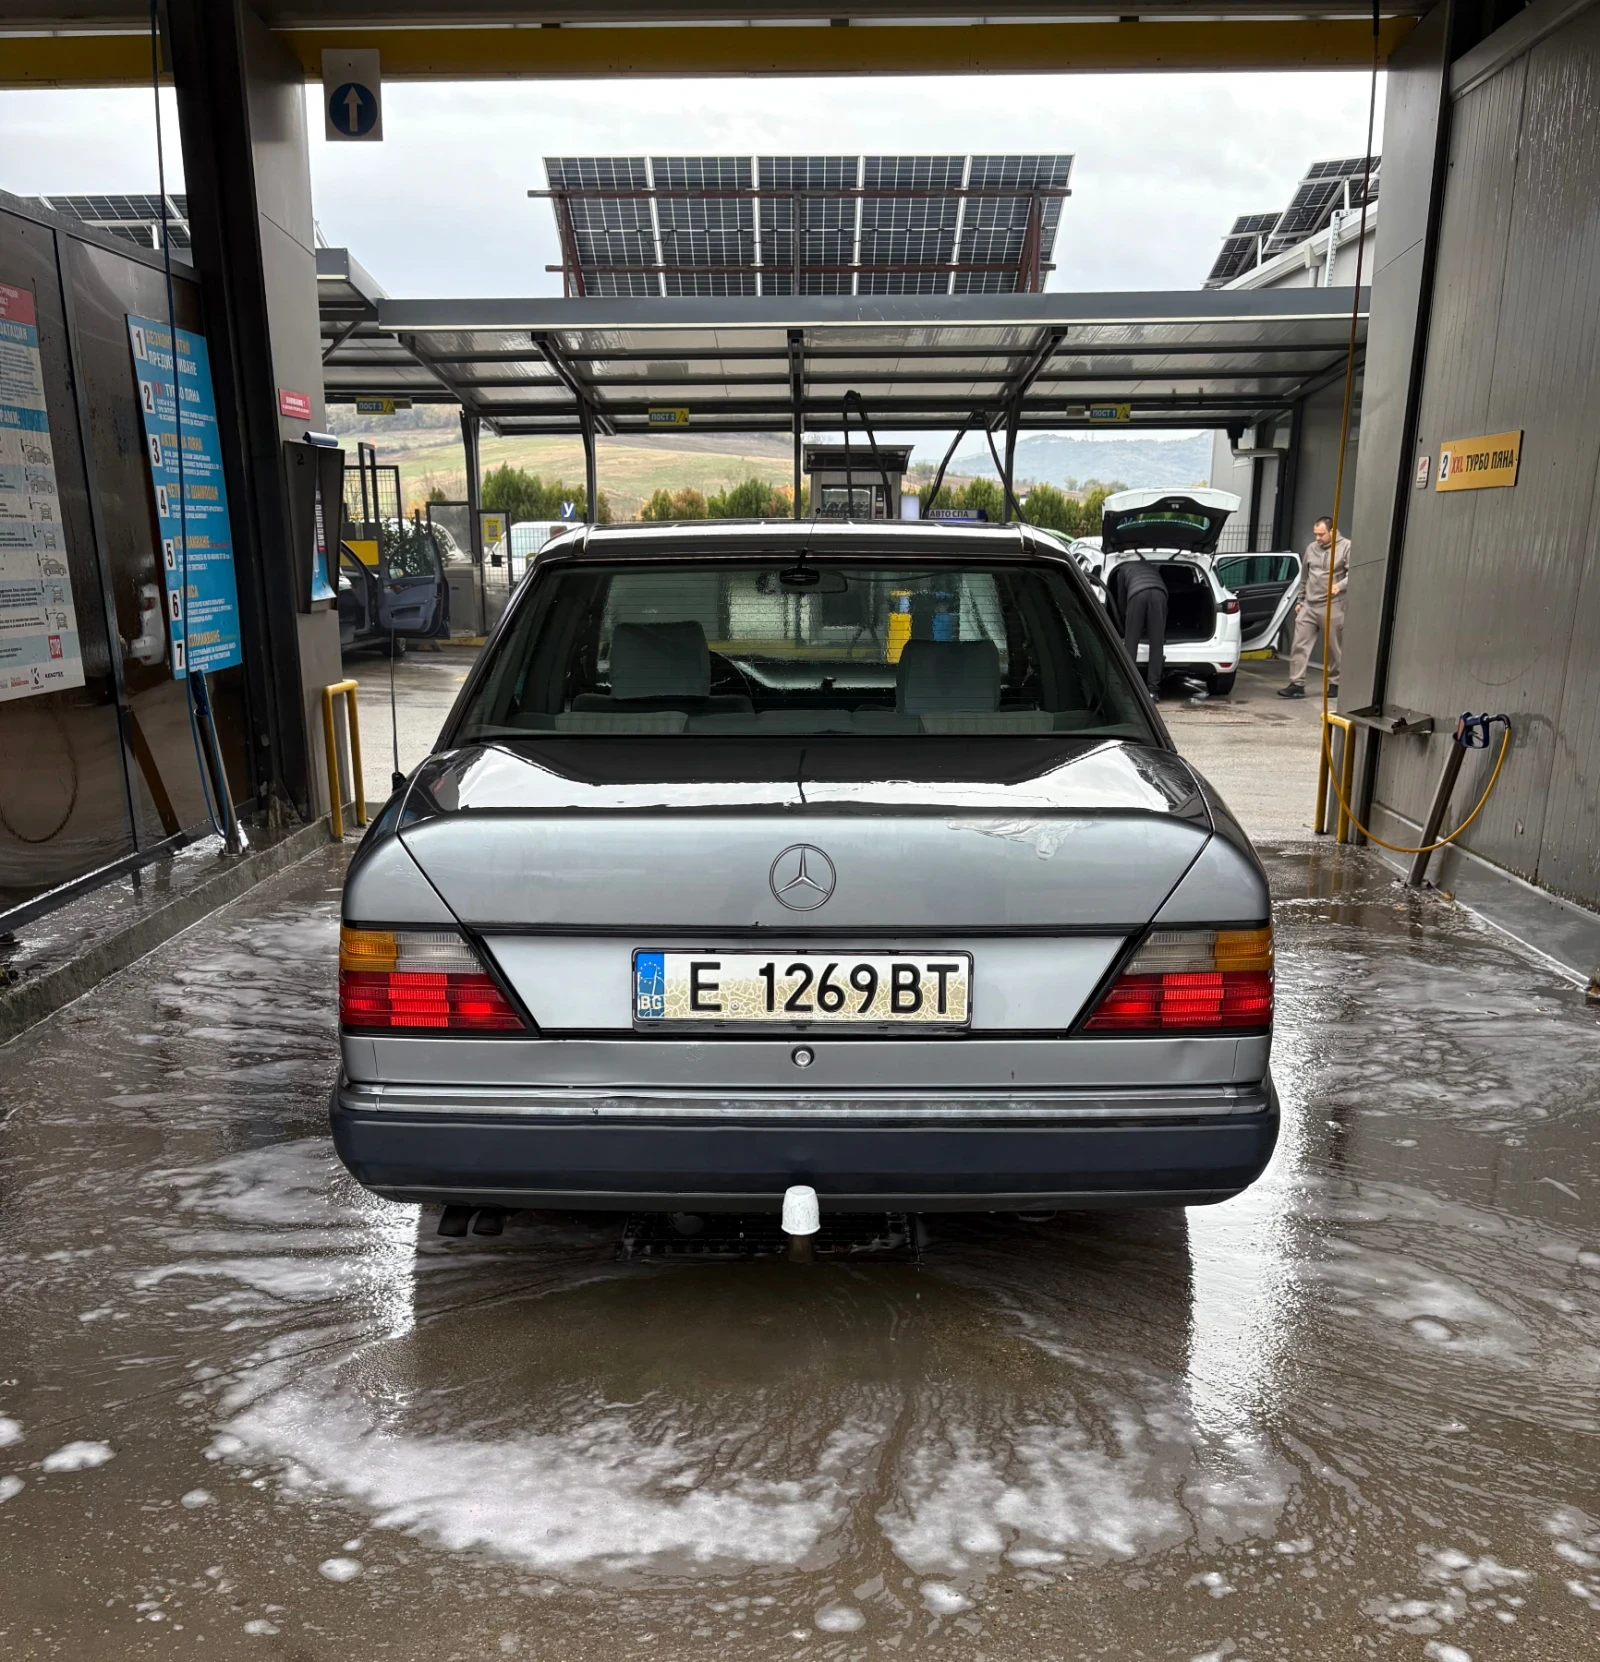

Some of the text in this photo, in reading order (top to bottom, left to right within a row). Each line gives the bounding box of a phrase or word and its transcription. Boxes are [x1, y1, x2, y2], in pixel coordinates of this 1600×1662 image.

[135, 329, 144, 357] 1
[143, 384, 153, 410] 2
[358, 402, 377, 410] ПОСТ
[651, 413, 669, 421] ПОСТ
[152, 438, 160, 464] 3
[296, 452, 304, 466] 2
[1441, 455, 1449, 479] 2
[1451, 456, 1463, 474] XXL
[1465, 452, 1490, 472] ТУРБО
[1491, 449, 1514, 470] ПЯНА
[160, 489, 167, 514] 4
[930, 510, 969, 518] АВТО СПА
[166, 543, 173, 568] 5
[172, 593, 179, 618] 6
[176, 643, 183, 667] 7
[640, 995, 663, 1010] BG
[690, 961, 722, 1012] E
